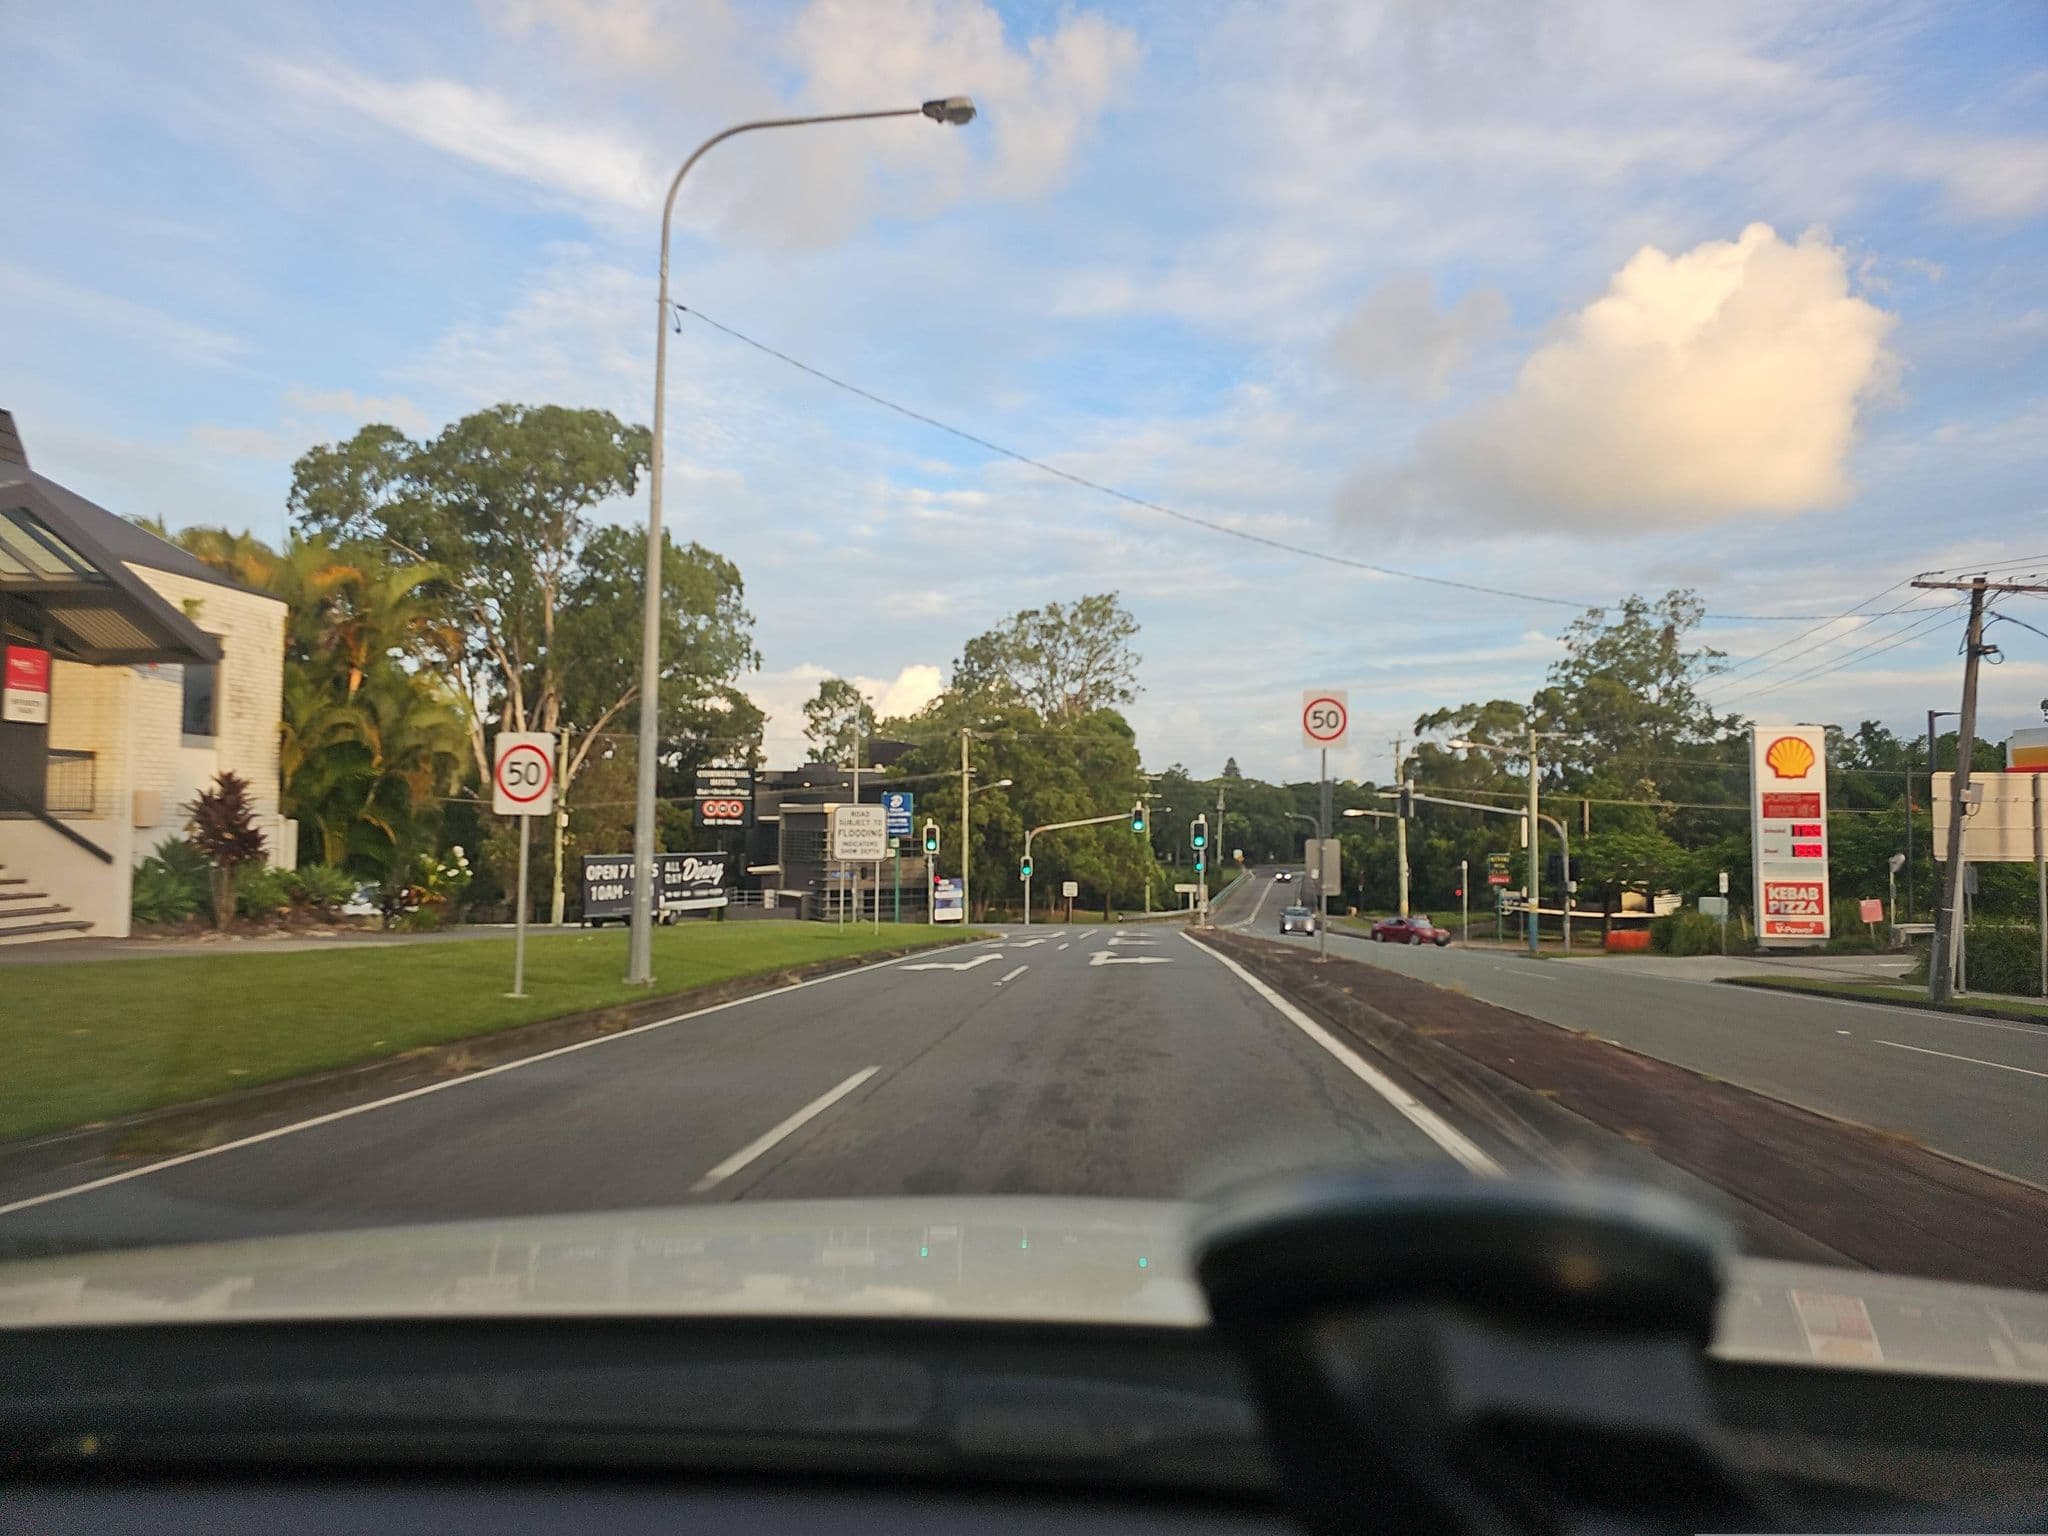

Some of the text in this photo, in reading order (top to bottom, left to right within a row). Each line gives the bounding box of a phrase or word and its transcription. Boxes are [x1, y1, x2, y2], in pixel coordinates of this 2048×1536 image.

[1313, 710, 1339, 729] 50
[508, 761, 541, 786] 50
[838, 829, 883, 838] FLOODING
[586, 864, 619, 881] OPEN
[619, 864, 629, 879] 7
[664, 861, 681, 872] ALL
[682, 857, 725, 886] Dining
[664, 873, 682, 884] DAY
[591, 884, 624, 902] 10AM
[1768, 886, 1819, 900] KEBAB
[1768, 900, 1820, 914] PIZZA
[1775, 923, 1814, 934] V-Power
